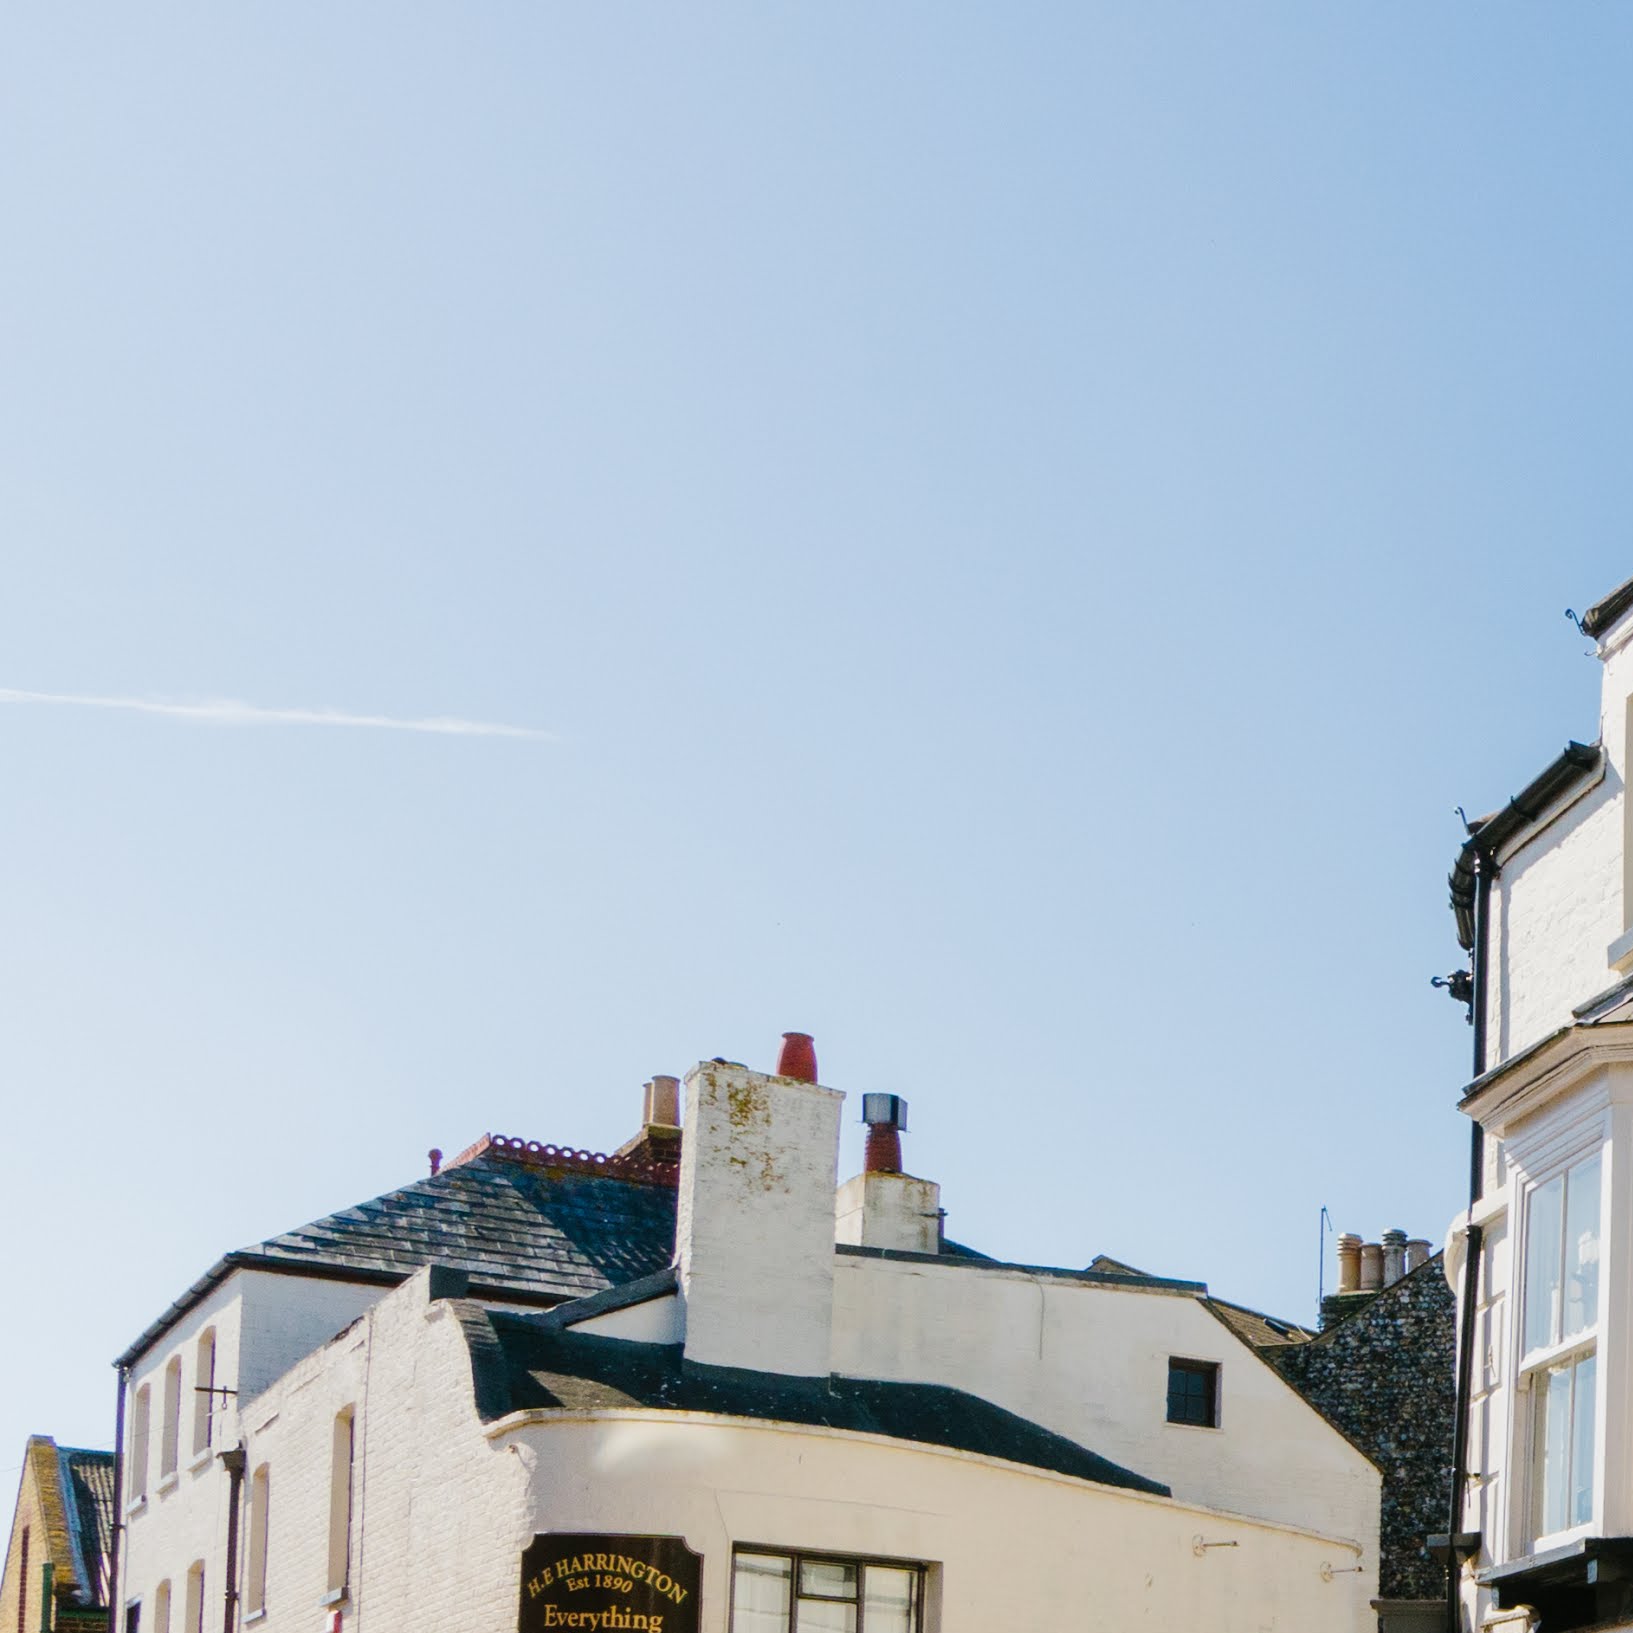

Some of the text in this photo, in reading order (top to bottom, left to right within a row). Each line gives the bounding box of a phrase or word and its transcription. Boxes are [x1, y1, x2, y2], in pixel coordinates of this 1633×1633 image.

[555, 1553, 688, 1604] HARRINGTON
[566, 1574, 633, 1593] Est 1890
